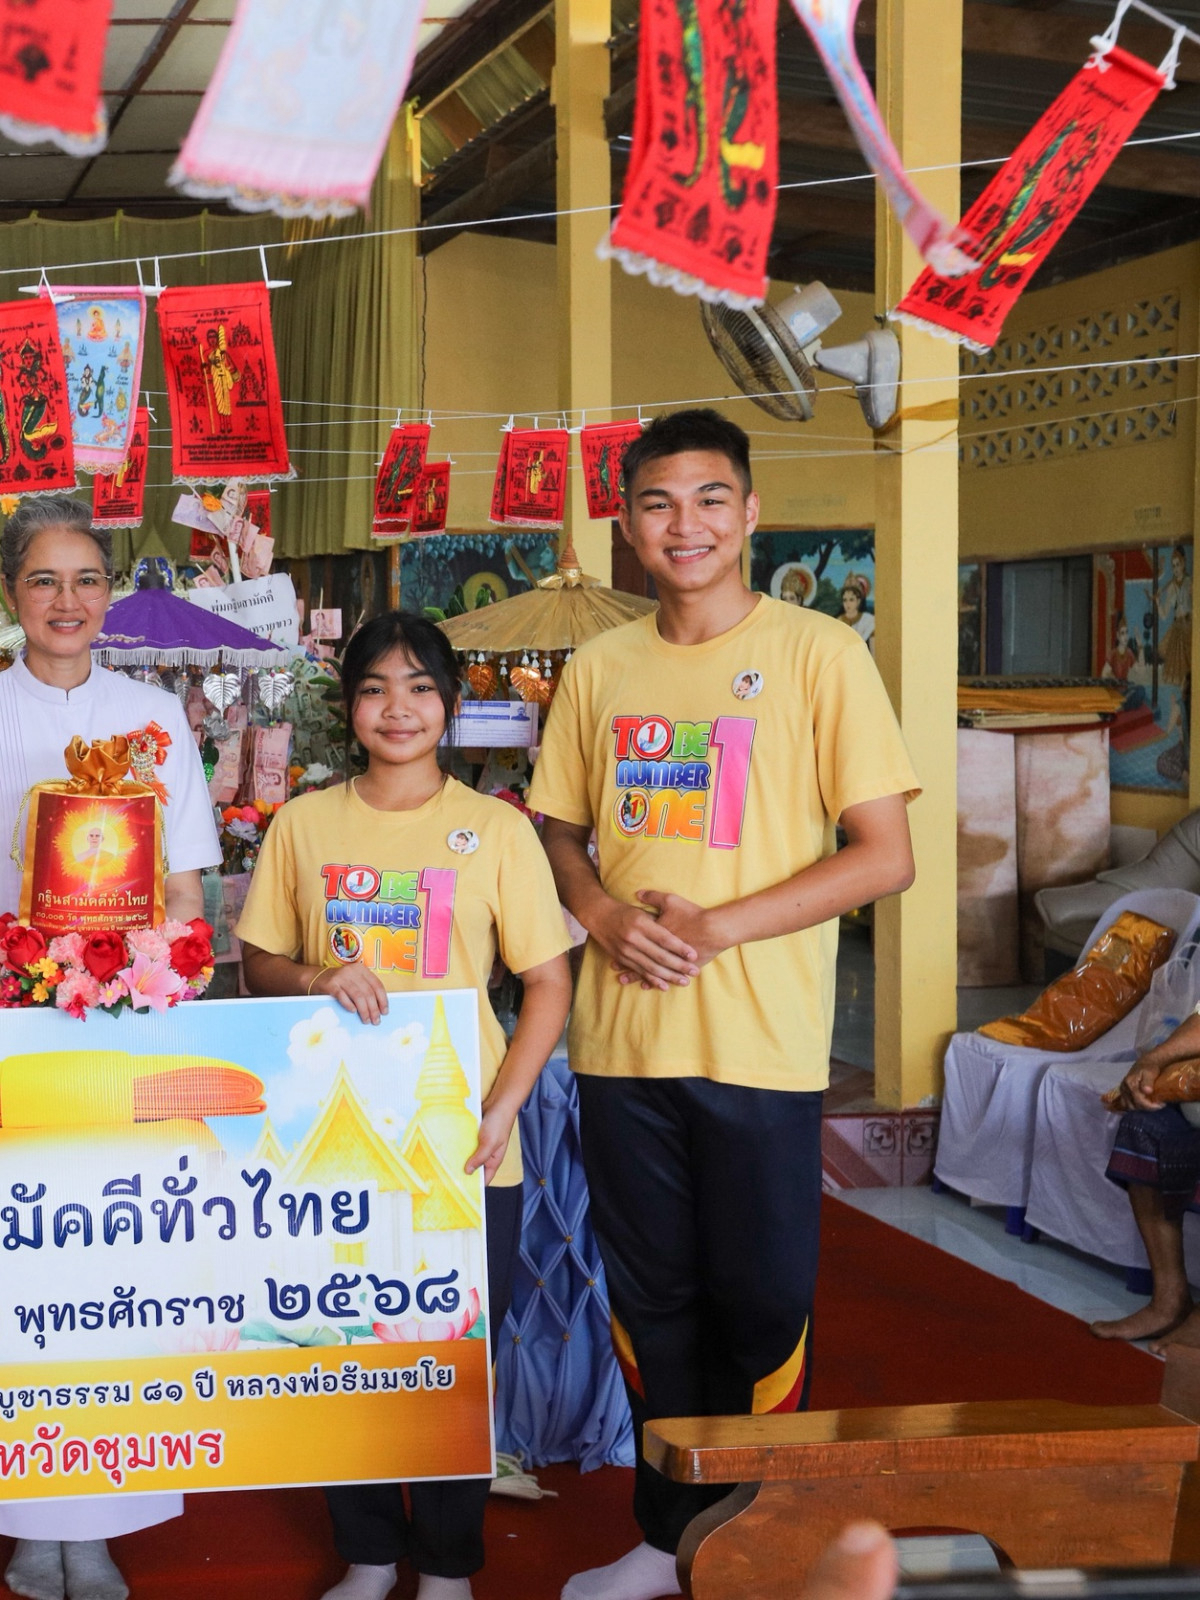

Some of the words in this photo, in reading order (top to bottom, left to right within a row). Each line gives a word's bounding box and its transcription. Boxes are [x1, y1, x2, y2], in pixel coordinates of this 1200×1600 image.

[249, 618, 293, 634] ทรายขาว
[611, 714, 674, 761] TO
[671, 721, 713, 758] BE
[616, 760, 711, 790] NUMBER
[613, 788, 707, 841] ONE
[37, 889, 148, 908] กฐินสามัคคีทั่วไทย
[321, 863, 381, 900] TO
[379, 870, 420, 901] BE
[325, 900, 421, 929] NUMBER
[328, 924, 418, 974] ONE
[14, 1285, 246, 1351] พุทธศักราช
[263, 1269, 461, 1323] ๒๕๖๘
[142, 1382, 184, 1403] ๘๑
[195, 1370, 215, 1399] ปี
[227, 1359, 456, 1398] หลวงพ่อธัมมชโย
